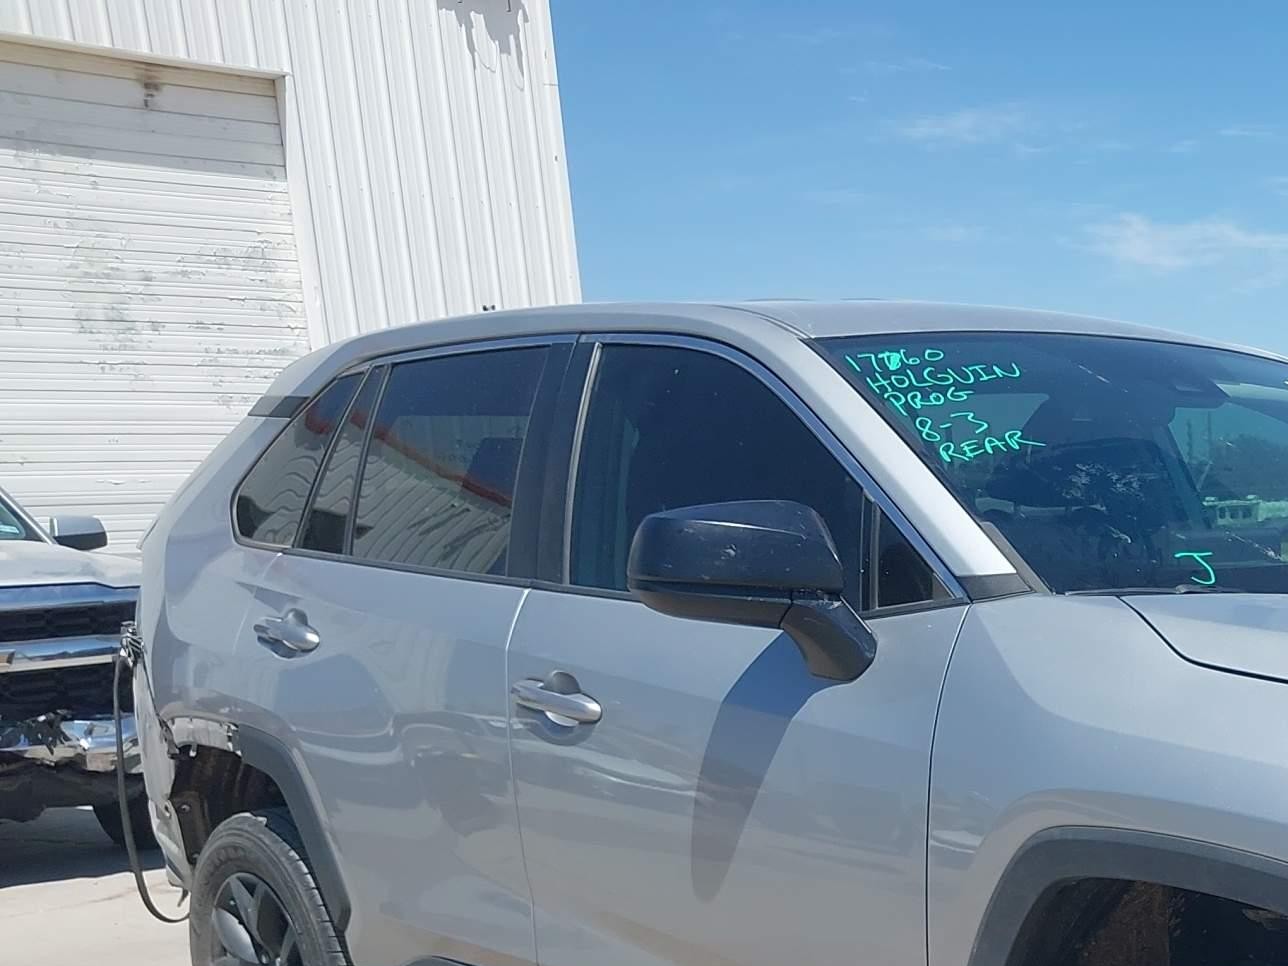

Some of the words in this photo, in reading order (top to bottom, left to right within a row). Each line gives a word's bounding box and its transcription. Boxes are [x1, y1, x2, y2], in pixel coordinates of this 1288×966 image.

[866, 362, 1021, 393] HOLGUIN
[884, 386, 974, 416] PROG
[915, 411, 988, 441] 8-3
[939, 430, 1047, 462] REAR
